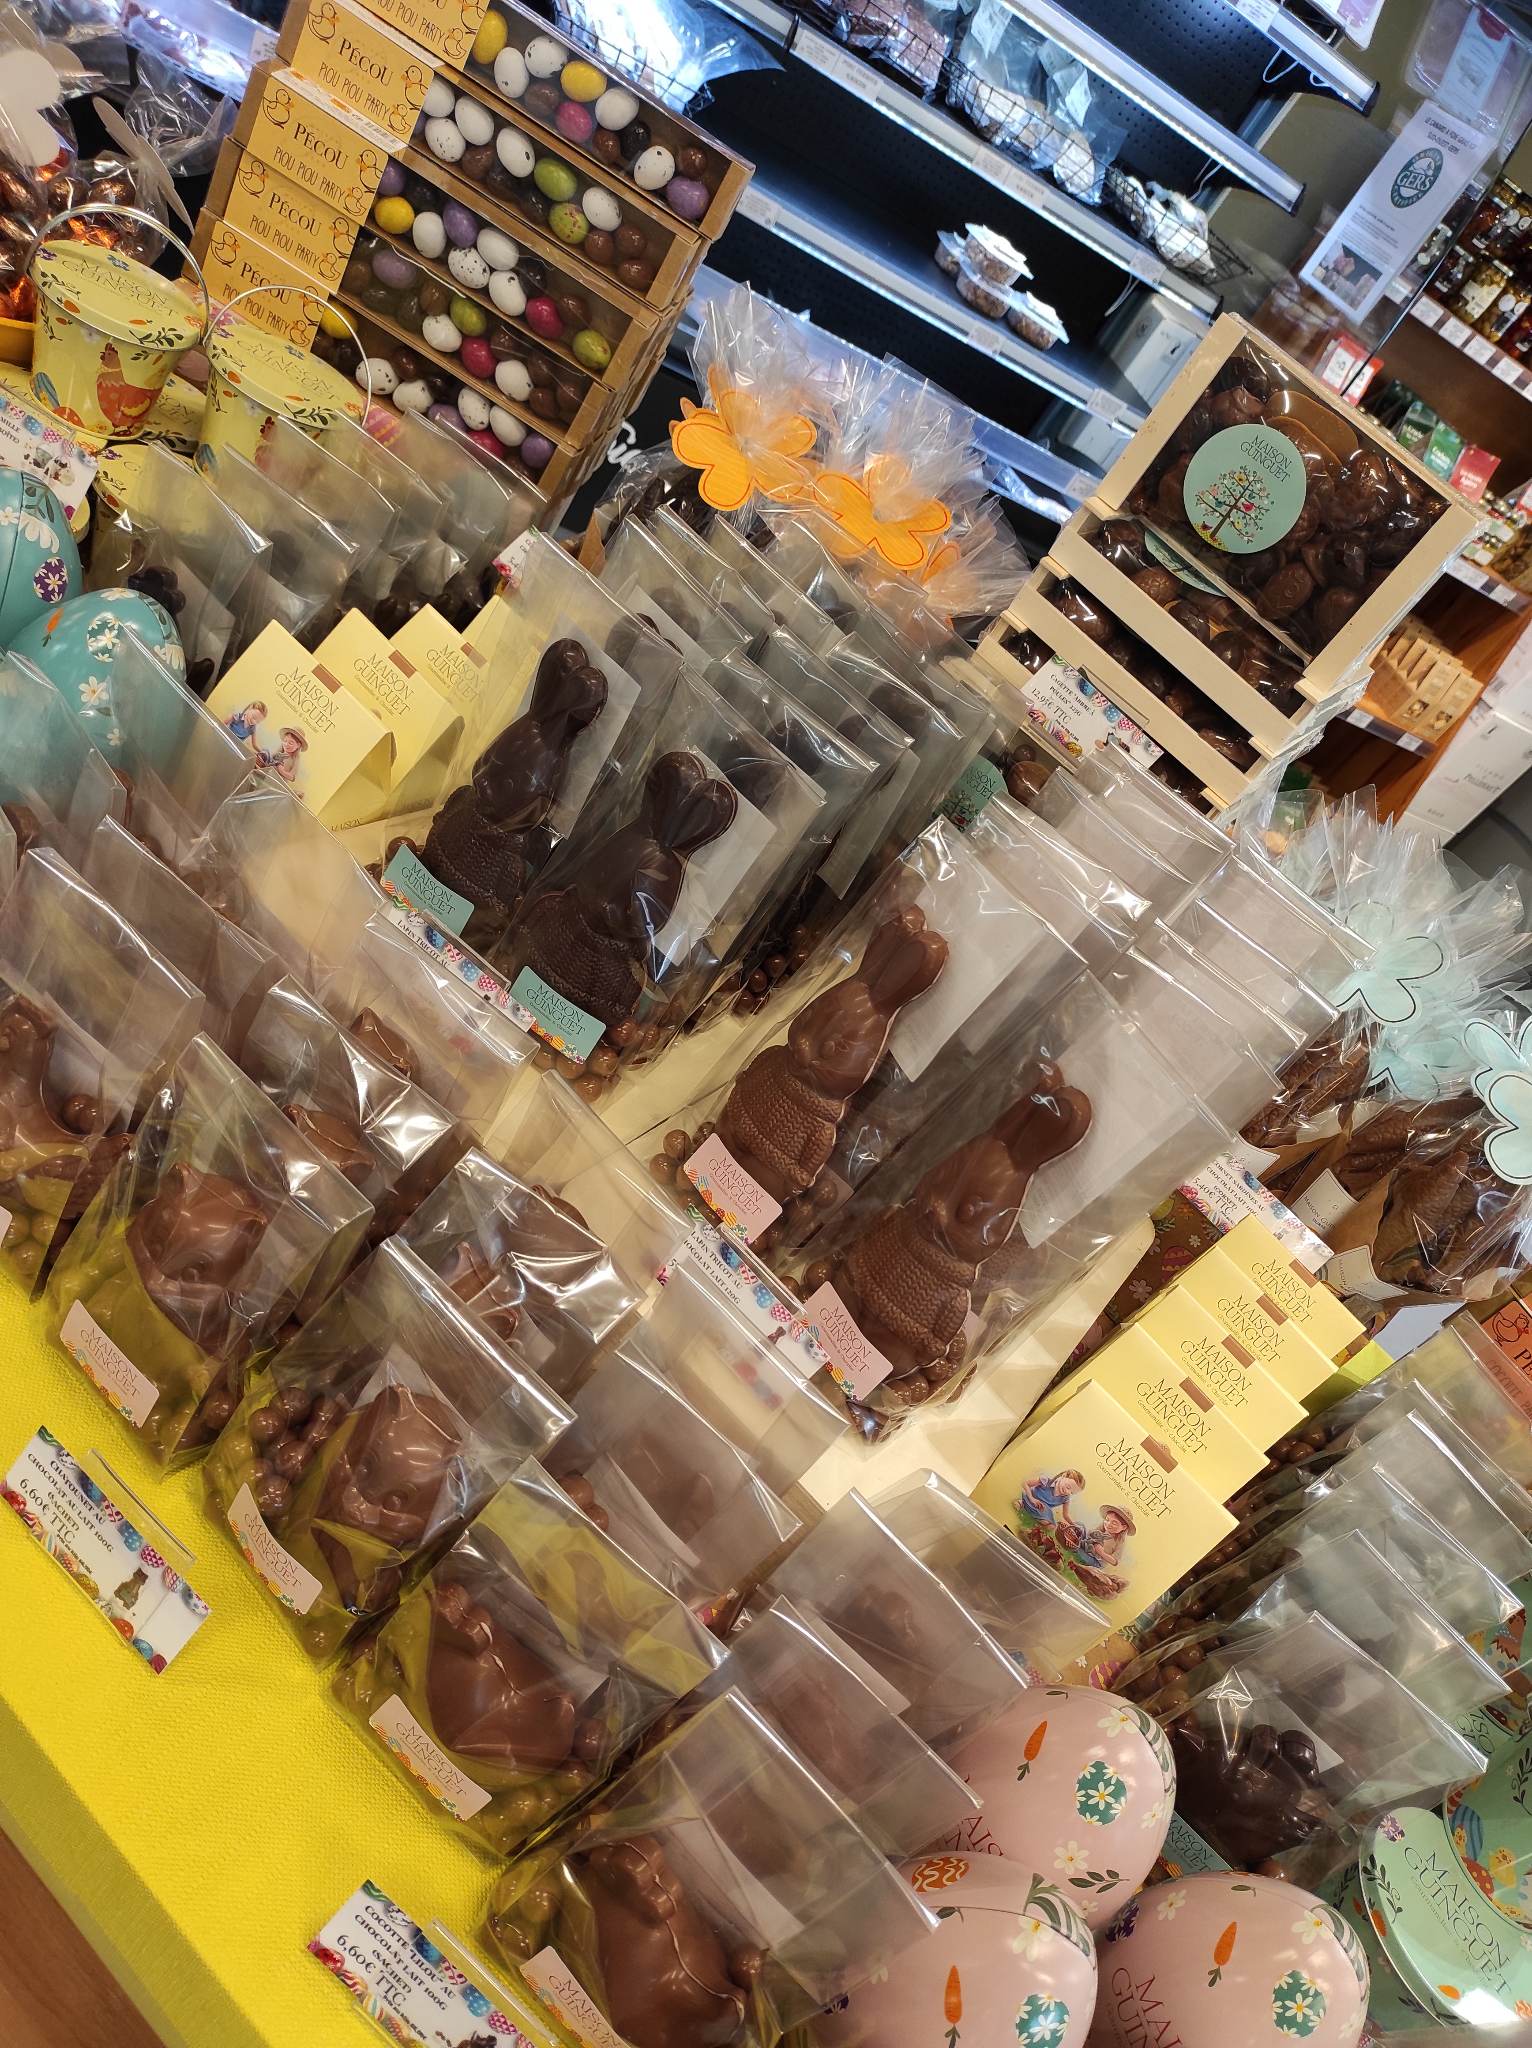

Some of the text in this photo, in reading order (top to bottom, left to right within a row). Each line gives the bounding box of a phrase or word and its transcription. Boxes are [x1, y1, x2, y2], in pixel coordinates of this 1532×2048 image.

[396, 2, 419, 28] PIOU
[419, 16, 446, 46] PARTY
[338, 38, 394, 86] PÉCOU
[320, 62, 341, 88] PIOU
[342, 77, 365, 102] PIOU
[366, 93, 390, 121] PARTY
[293, 122, 350, 170] PÉCOU
[274, 146, 346, 204] PIOU PIOU PARTY
[1397, 170, 1434, 191] GERS
[268, 192, 322, 238] PÉCOU
[250, 214, 320, 270] PIOU PIOU PARTY
[62, 260, 178, 316] GUINGUET
[80, 258, 168, 306] MAISON
[240, 260, 293, 306] PÉCOU
[244, 295, 266, 320] PIOU
[268, 312, 290, 335] PARTY
[1240, 441, 1291, 482] GUINGUET
[1251, 434, 1292, 470] MAISON
[290, 666, 340, 717] MAISON
[354, 658, 411, 716] GUINGUET
[366, 652, 415, 700] MAISON
[426, 649, 480, 702] GUINGUET
[440, 644, 484, 689] MAISON
[274, 673, 336, 733] GUINGUET
[1054, 705, 1072, 724] TTC
[400, 866, 456, 916] GUINGUET
[410, 862, 454, 904] MAISON
[397, 920, 416, 941] LAPIN
[415, 937, 441, 961] TRICOT
[526, 988, 586, 1036] GUINGUET
[537, 984, 584, 1024] MAISON
[708, 1158, 762, 1218] GUINGUET
[718, 1156, 764, 1204] MAISON
[1215, 1195, 1234, 1216] TTC
[690, 1230, 708, 1254] LAPIN
[709, 1251, 734, 1280] TRICOT
[710, 1270, 726, 1288] LAIT
[1252, 1262, 1313, 1322] GUINGUET
[1266, 1258, 1317, 1309] MAISON
[818, 1306, 870, 1376] GUINGUET
[830, 1306, 873, 1358] MAISON
[1217, 1298, 1281, 1362] GUINGUET
[1232, 1294, 1285, 1348] MAISON
[80, 1329, 140, 1396] GUINGUET
[89, 1327, 138, 1382] MAISON
[1180, 1340, 1249, 1408] GUINGUET
[1197, 1336, 1252, 1392] MAISON
[1136, 1382, 1208, 1454] GUINGUET
[1154, 1378, 1212, 1437] MAISON
[50, 1460, 106, 1525] CHATOUNET AU
[1095, 1442, 1172, 1518] GUINGUET
[1114, 1437, 1176, 1500] MAISON
[27, 1453, 114, 1554] CHOCOLAT AU LAIT 100G
[47, 1492, 80, 1532] (SACHET)
[50, 1512, 76, 1544] TTC
[244, 1513, 302, 1586] GUINGUET
[251, 1515, 298, 1575] MAISON
[396, 1722, 467, 1796] GUINGUET
[408, 1726, 464, 1784] MAISON
[1404, 1846, 1512, 1994] GUINGUET
[1426, 1852, 1511, 1970] MAISON
[354, 1914, 448, 2011] CHOCOLAT LAIT 100G
[364, 1905, 410, 1950] COCOTTE
[440, 1986, 457, 2000] AU
[372, 1948, 412, 1994] (SACHET)
[376, 1970, 407, 2008] TTC
